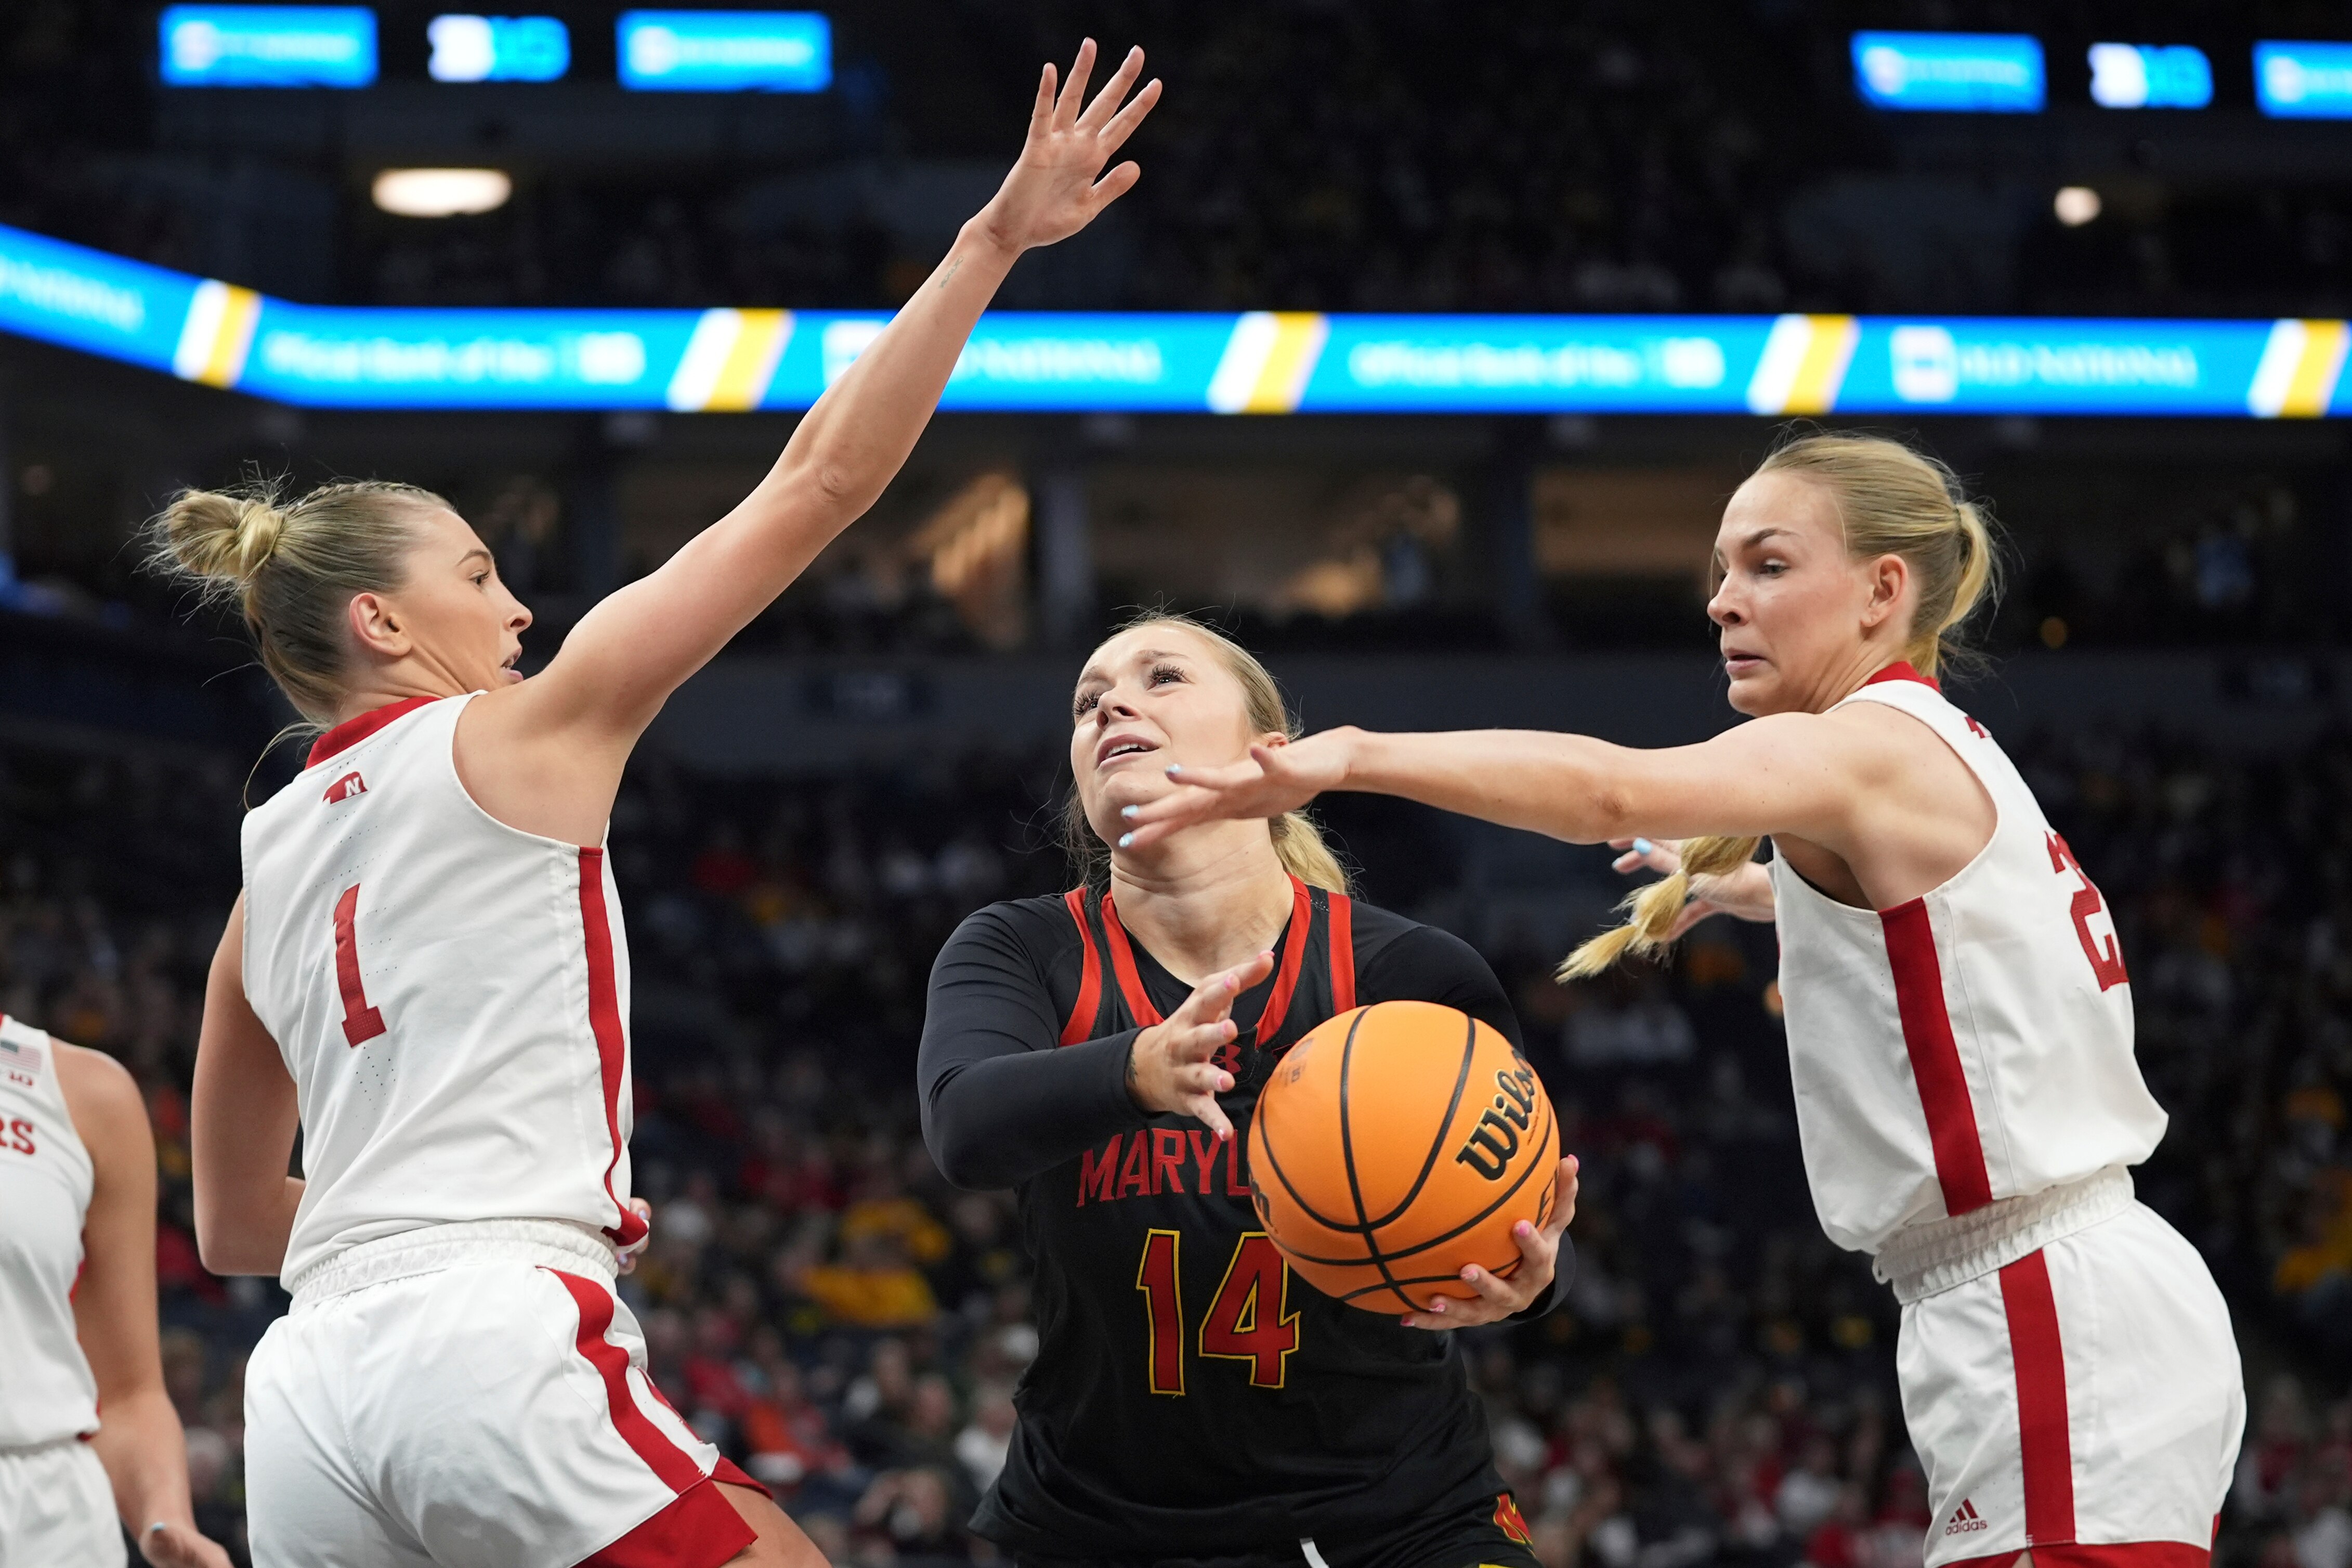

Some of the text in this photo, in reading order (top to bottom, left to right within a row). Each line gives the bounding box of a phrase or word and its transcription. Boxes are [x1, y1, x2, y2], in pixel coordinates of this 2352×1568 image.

[333, 883, 386, 1048] 1
[1076, 1128, 1250, 1208] MARYL
[1135, 1228, 1301, 1395] 14
[1945, 1519, 1988, 1536] adidas
